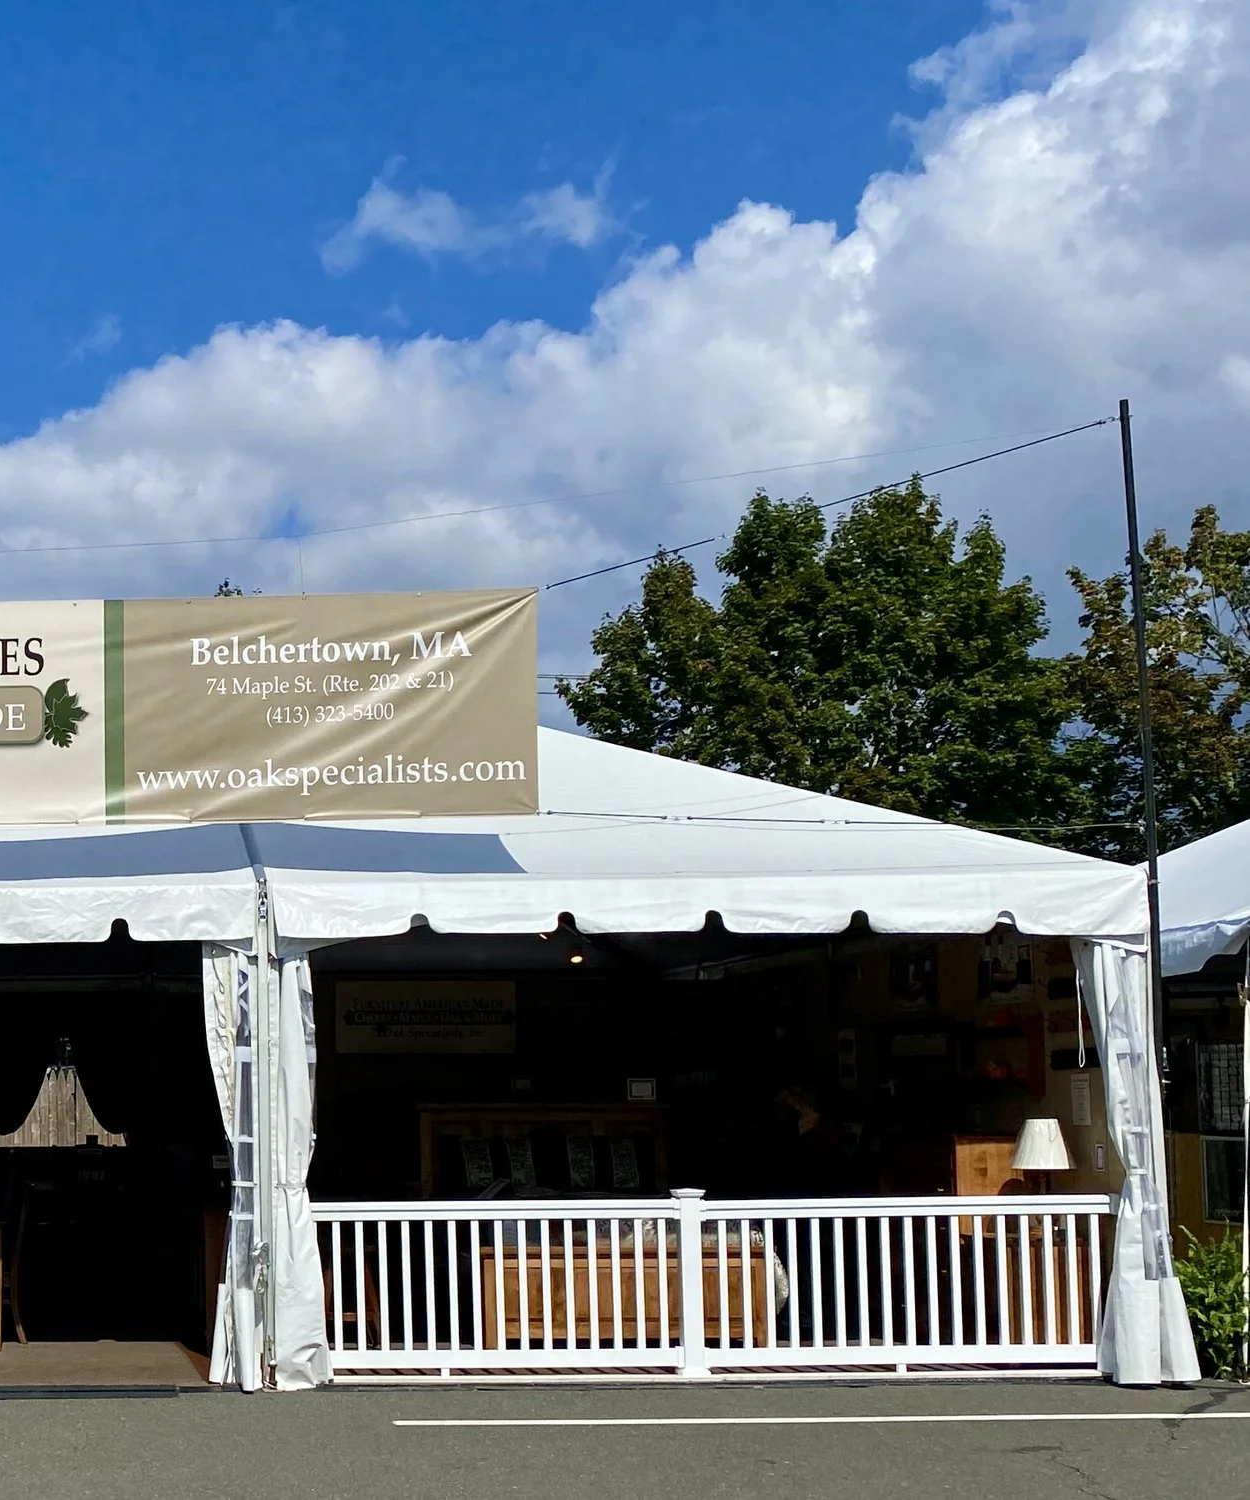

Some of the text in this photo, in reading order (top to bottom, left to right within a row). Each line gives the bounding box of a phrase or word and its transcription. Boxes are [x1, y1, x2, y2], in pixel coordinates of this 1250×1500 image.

[190, 630, 472, 667] Belchertown, MA
[205, 670, 455, 700] 74 Maple St. (Rte. 202 & 21)
[266, 703, 395, 728] (413) 323-5400
[136, 755, 527, 796] www.oakspecialists.com
